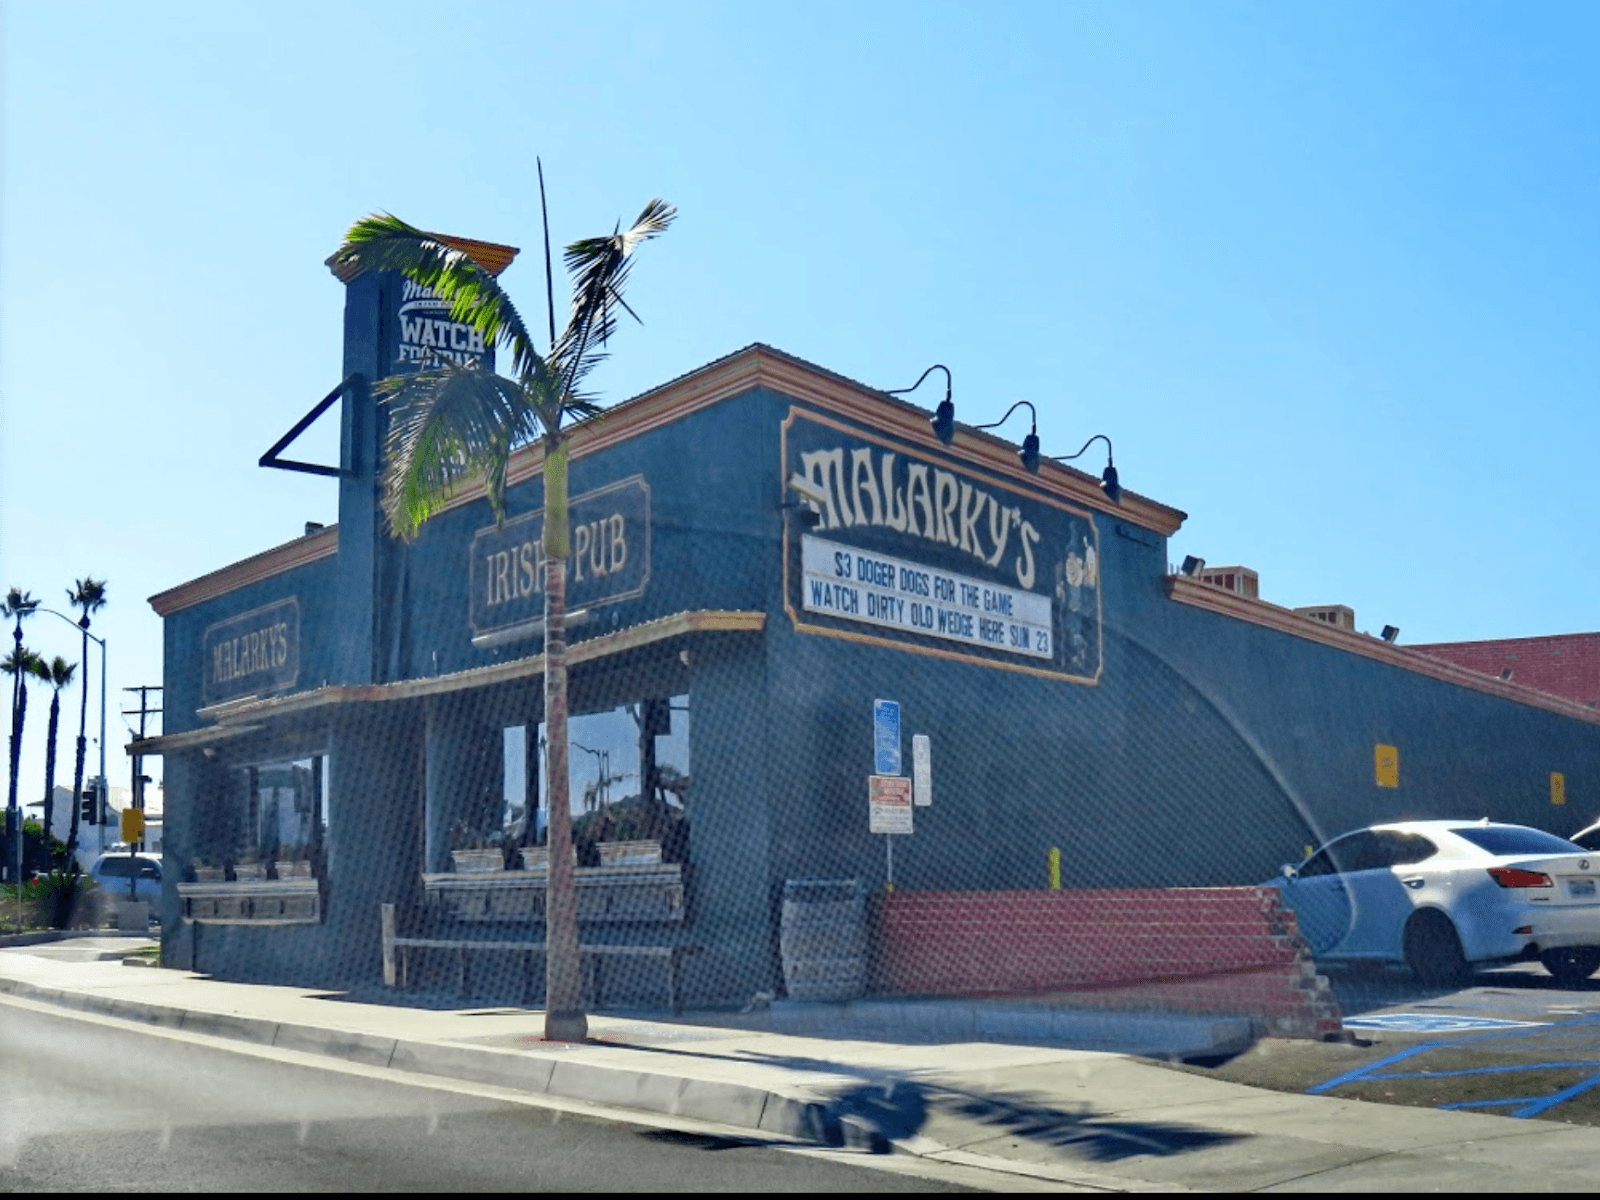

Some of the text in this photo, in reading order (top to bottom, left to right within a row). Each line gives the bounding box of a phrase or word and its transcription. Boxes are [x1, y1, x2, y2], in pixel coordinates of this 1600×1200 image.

[400, 314, 485, 354] WATCH
[575, 513, 627, 582] PUB
[811, 580, 1049, 653] WATCH DIRTY OLD WEDGE HERE SUN 23
[857, 556, 896, 589] DOGER
[900, 567, 930, 597] DOGS
[934, 575, 956, 602] FOR
[960, 582, 979, 608] THE
[983, 589, 1013, 616] GAME
